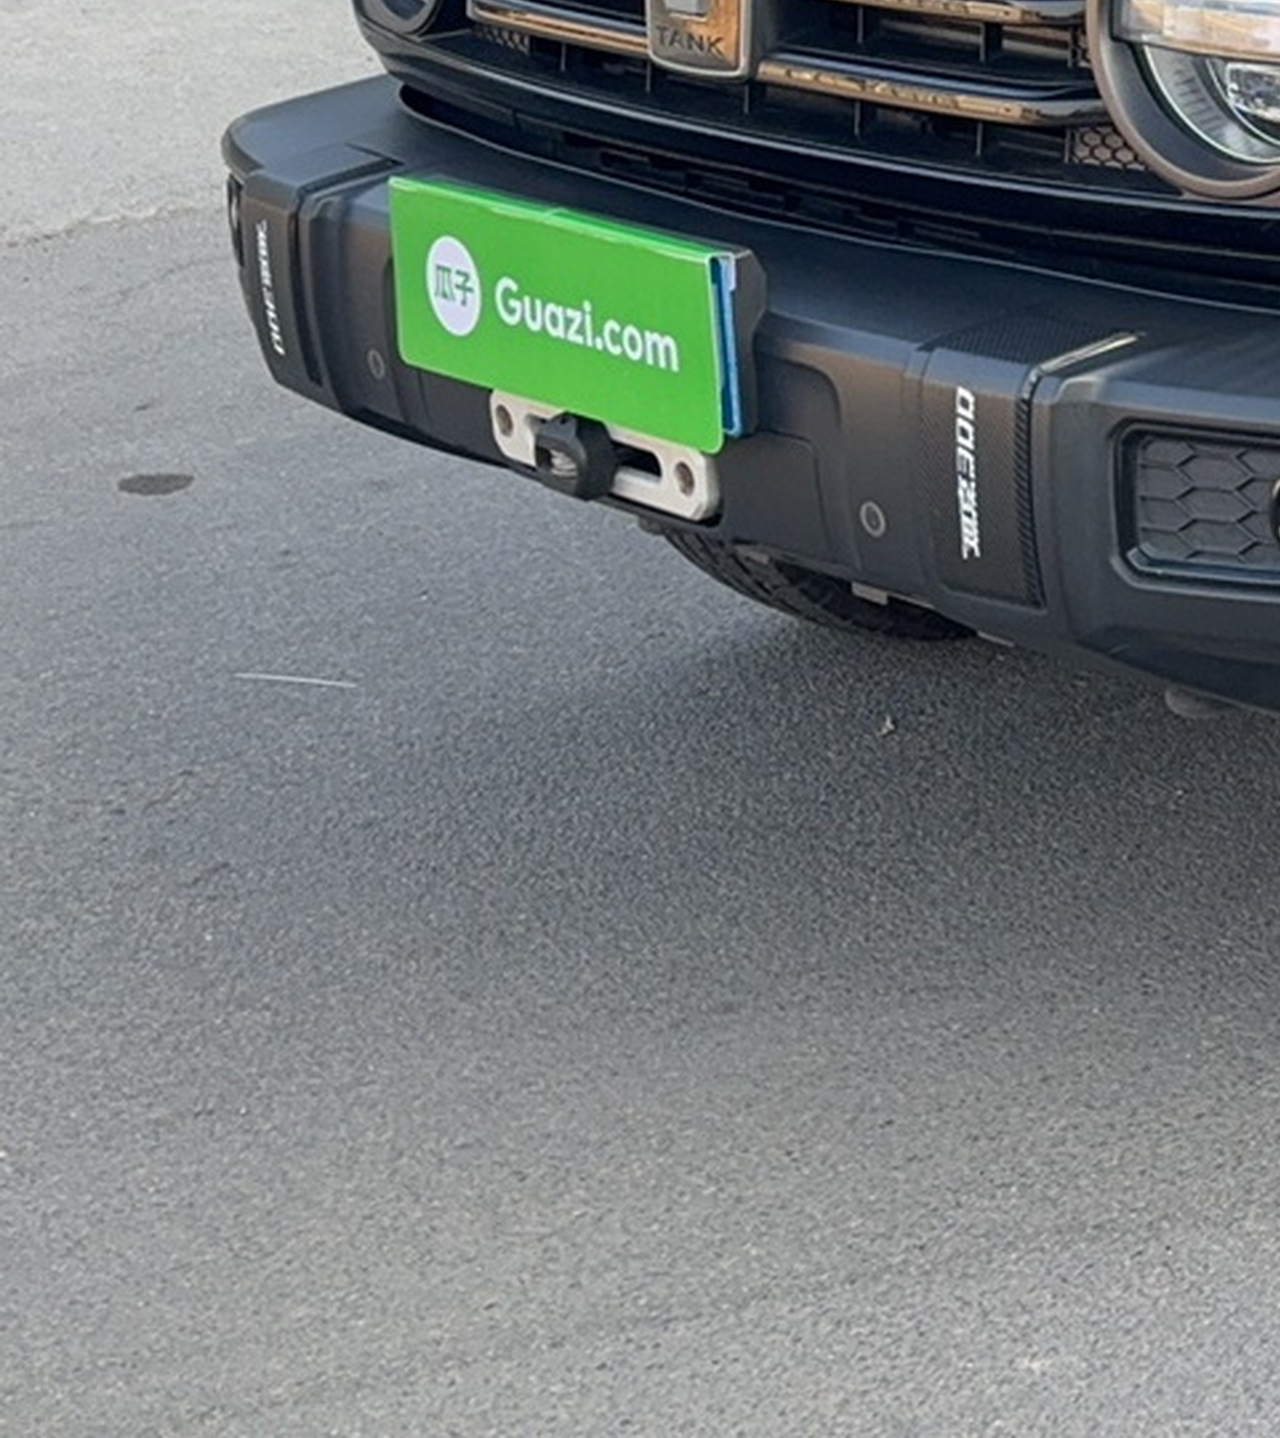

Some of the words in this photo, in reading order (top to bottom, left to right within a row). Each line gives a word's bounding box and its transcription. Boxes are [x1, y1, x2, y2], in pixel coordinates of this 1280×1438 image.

[655, 25, 725, 57] TANK
[434, 264, 475, 306] 瓜子
[494, 276, 680, 373] Guazi.com
